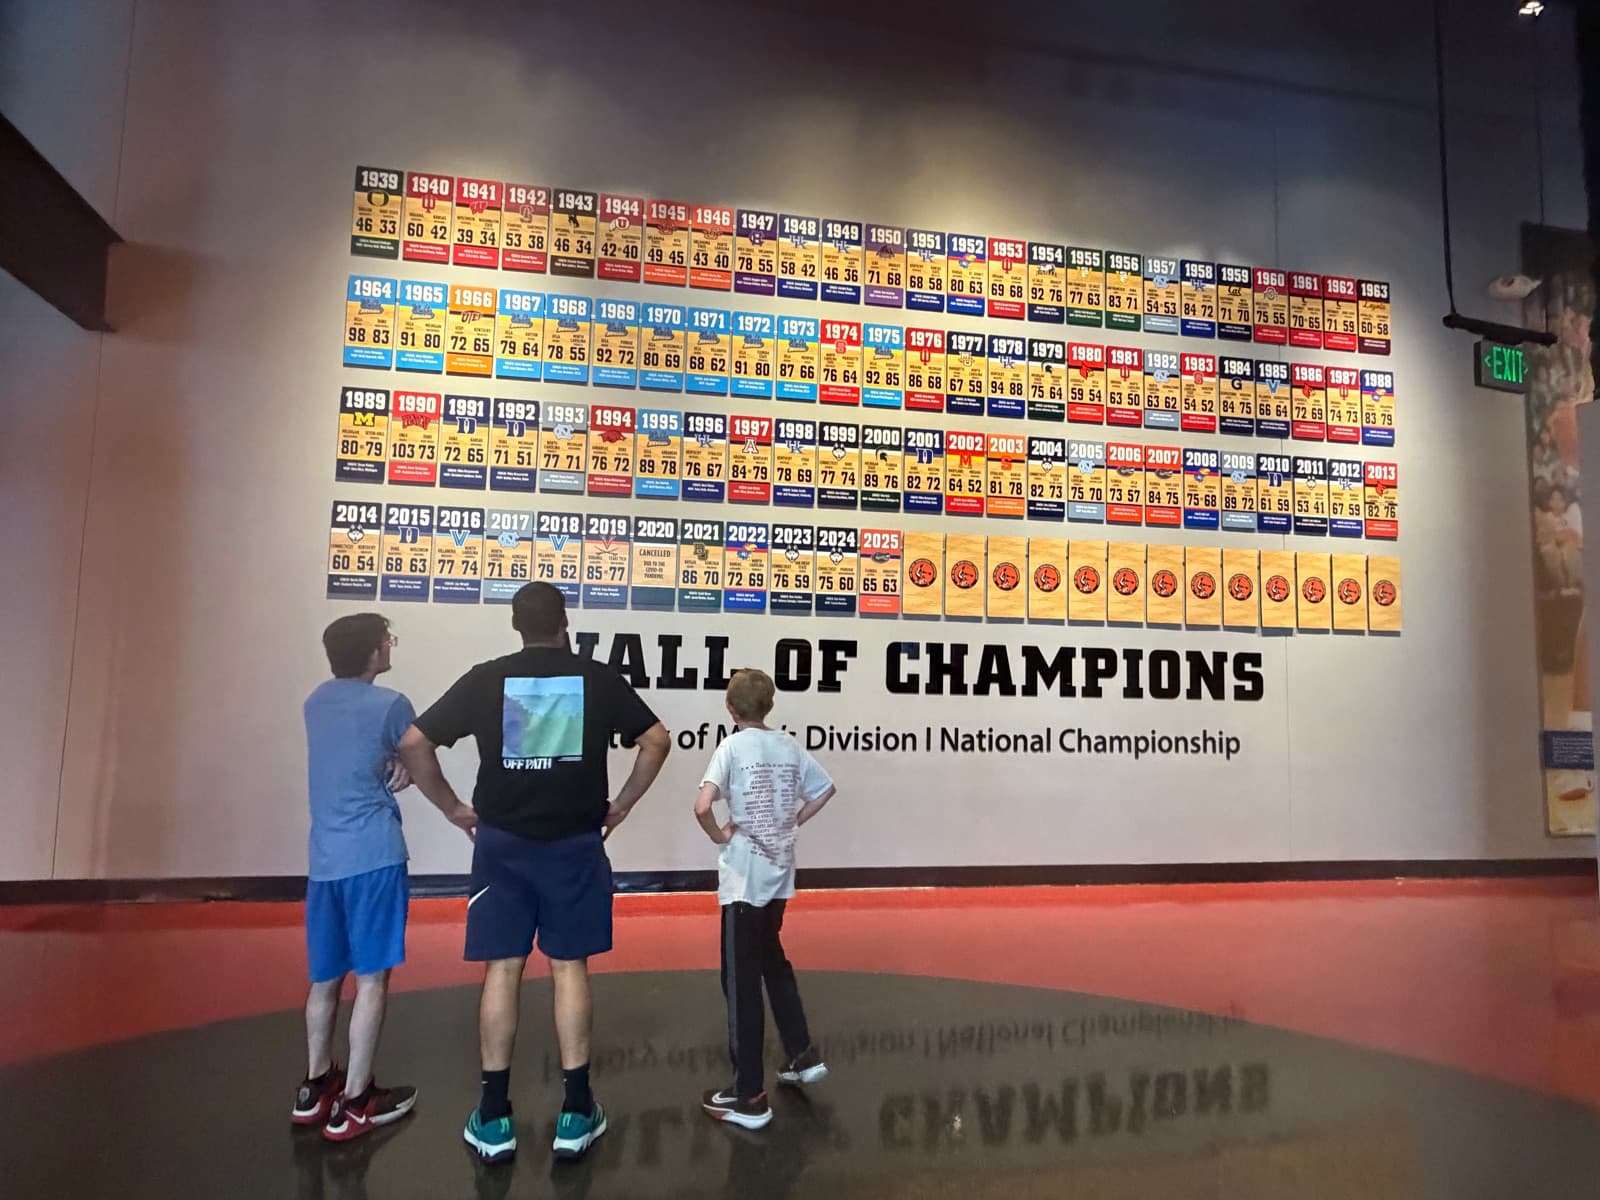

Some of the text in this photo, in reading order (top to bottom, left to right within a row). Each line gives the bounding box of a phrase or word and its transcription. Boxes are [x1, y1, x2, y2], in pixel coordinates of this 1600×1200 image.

[362, 171, 398, 189] 1939
[412, 176, 449, 195] 1940
[462, 182, 496, 200] 1941
[510, 188, 546, 206] 1942
[558, 193, 593, 210] 1943
[605, 198, 639, 216] 1944
[651, 203, 685, 221] 1945
[697, 208, 730, 226] 1946
[356, 218, 396, 234] 46 33
[741, 213, 773, 230] 1947
[783, 218, 816, 236] 1948
[826, 223, 859, 240] 1949
[871, 228, 901, 244] 1950
[912, 232, 941, 249] 1951
[952, 237, 983, 254] 1952
[993, 242, 1022, 258] 1953
[1032, 246, 1062, 262] 1954
[1071, 250, 1100, 266] 1955
[738, 257, 773, 272] 78 55
[1110, 255, 1138, 271] 1956
[1147, 259, 1176, 275] 1957
[1185, 263, 1213, 279] 1958
[1221, 268, 1248, 283] 1959
[1257, 271, 1285, 286] 1960
[1292, 275, 1319, 290] 1961
[354, 280, 391, 298] 1964
[405, 285, 443, 302] 1965
[1327, 279, 1353, 295] 1962
[1361, 283, 1388, 298] 1963
[455, 289, 492, 307] 1966
[504, 294, 541, 312] 1967
[1070, 292, 1100, 305] 77 63
[552, 298, 587, 315] 1968
[601, 303, 635, 320] 1969
[648, 308, 680, 324] 1970
[693, 311, 724, 328] 1971
[738, 315, 770, 332] 1972
[349, 328, 389, 343] 98 83
[783, 319, 814, 337] 1973
[825, 323, 857, 340] 1974
[869, 327, 899, 344] 1975
[1361, 322, 1388, 335] 60 58
[910, 331, 942, 347] 1976
[951, 335, 983, 351] 1977
[992, 338, 1022, 355] 1978
[1032, 342, 1063, 358] 1979
[1072, 346, 1101, 362] 1980
[1111, 350, 1138, 365] 1981
[690, 357, 725, 371] 68 62
[1147, 352, 1176, 368] 1982
[1184, 356, 1213, 372] 1983
[1224, 360, 1250, 375] 1984
[1493, 346, 1523, 384] EXIT
[1259, 363, 1287, 379] 1985
[1295, 367, 1322, 382] 1986
[1330, 370, 1356, 385] 1987
[909, 375, 941, 389] 86 68
[1364, 373, 1391, 388] 1988
[346, 391, 385, 409] 1989
[399, 395, 436, 413] 1990
[449, 399, 484, 417] 1991
[498, 402, 535, 420] 1992
[547, 406, 584, 422] 1993
[595, 410, 631, 427] 1994
[1259, 404, 1287, 417] 66 64
[642, 413, 678, 429] 1995
[688, 416, 723, 433] 1996
[734, 419, 769, 436] 1997
[779, 422, 813, 439] 1998
[823, 426, 856, 442] 1999
[865, 429, 899, 445] 2000
[908, 432, 940, 448] 2001
[949, 435, 982, 451] 2002
[990, 438, 1023, 453] 2003
[342, 441, 382, 456] 80 79
[1032, 441, 1062, 456] 2004
[1070, 444, 1103, 459] 2005
[1110, 446, 1141, 462] 2006
[1148, 449, 1179, 464] 2007
[639, 460, 676, 475] 89 78
[1186, 452, 1217, 467] 2008
[1224, 455, 1254, 469] 2009
[1260, 458, 1289, 473] 2010
[1296, 460, 1324, 475] 2011
[1332, 463, 1360, 477] 2012
[1368, 465, 1395, 479] 2013
[949, 478, 981, 492] 64 52
[1261, 499, 1289, 511] 61 59
[336, 505, 377, 524] 2014
[389, 508, 430, 526] 2015
[440, 511, 480, 528] 2016
[492, 514, 529, 531] 2017
[541, 516, 579, 533] 2018
[590, 518, 626, 535] 2019
[638, 521, 674, 538] 2020
[684, 524, 720, 540] 2021
[729, 526, 766, 543] 2022
[775, 528, 812, 545] 2023
[819, 531, 855, 547] 2024
[864, 533, 898, 549] 2025
[639, 548, 671, 558] CANCELLED
[332, 555, 374, 570] 60 54
[386, 558, 426, 572] 68 63
[438, 560, 478, 574] 77 74
[488, 563, 527, 577] 71 65
[538, 565, 576, 579] 79 62
[587, 565, 624, 581] 85 77
[682, 570, 697, 584] 86
[704, 571, 718, 585] 70
[728, 573, 763, 587] 72 69
[774, 574, 809, 588] 76 59
[819, 576, 853, 590] 75 60
[863, 579, 897, 592] 65 63
[775, 638, 858, 692] OF
[886, 641, 1264, 702] CHAMPIONS
[678, 723, 709, 751] of
[805, 725, 918, 752] Division
[940, 727, 1052, 753] National
[1059, 728, 1241, 760] Championship
[525, 757, 552, 770] PATH
